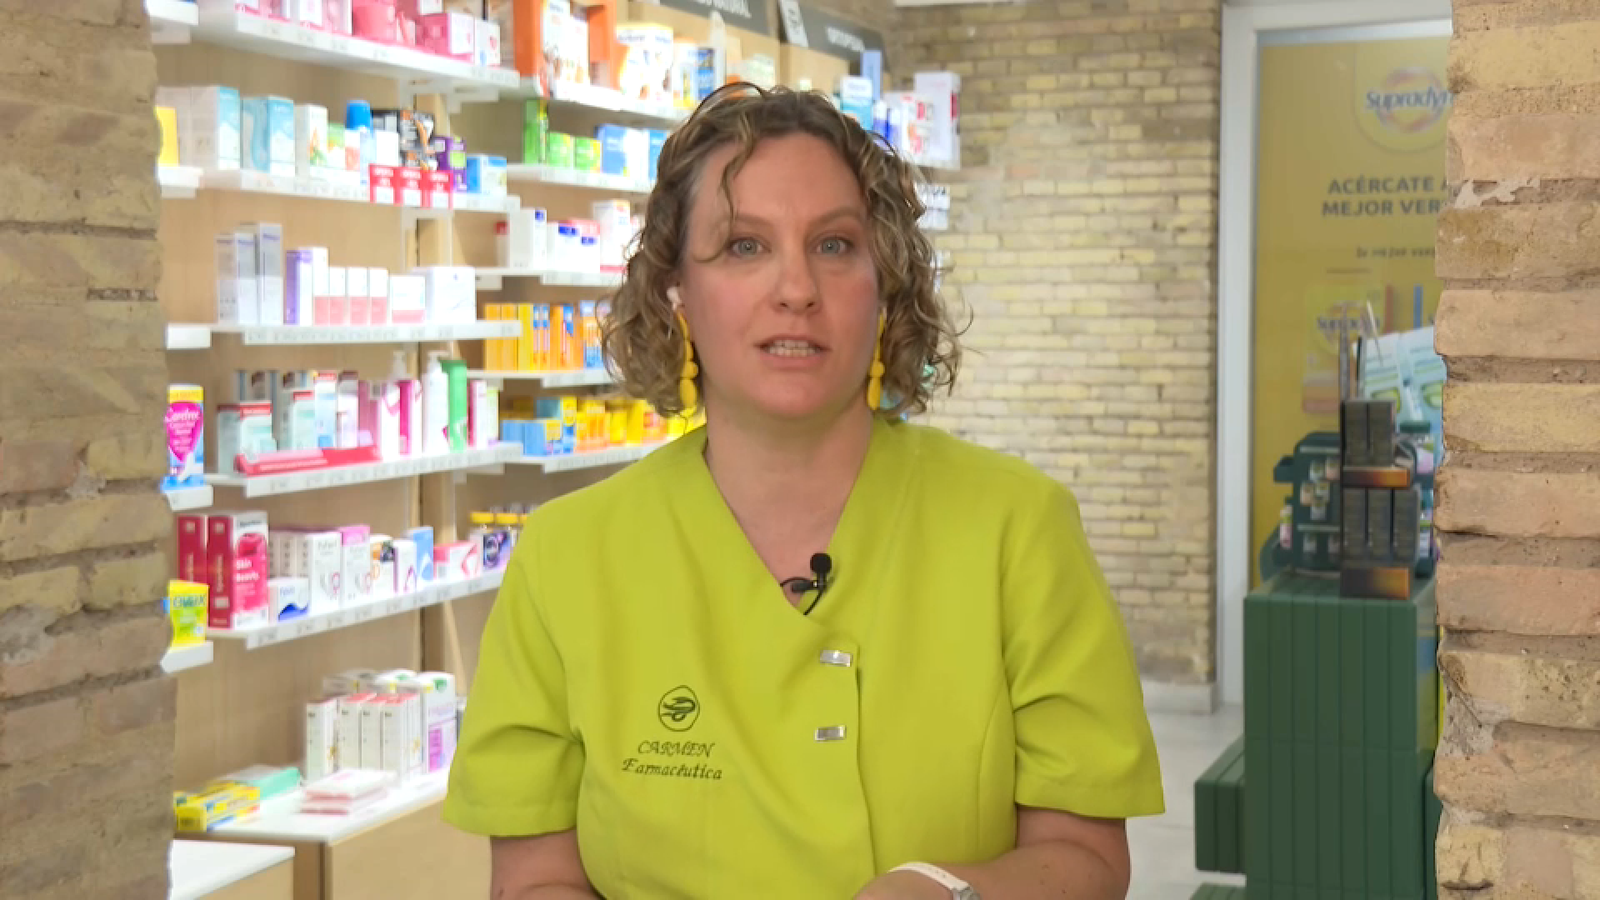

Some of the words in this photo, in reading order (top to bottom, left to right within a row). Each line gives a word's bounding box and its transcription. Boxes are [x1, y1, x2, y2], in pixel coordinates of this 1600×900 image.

[1327, 174, 1434, 194] ACÉRCATE
[1322, 200, 1393, 217] MEJOR
[1400, 198, 1444, 215] VER
[637, 740, 715, 758] CARMEN
